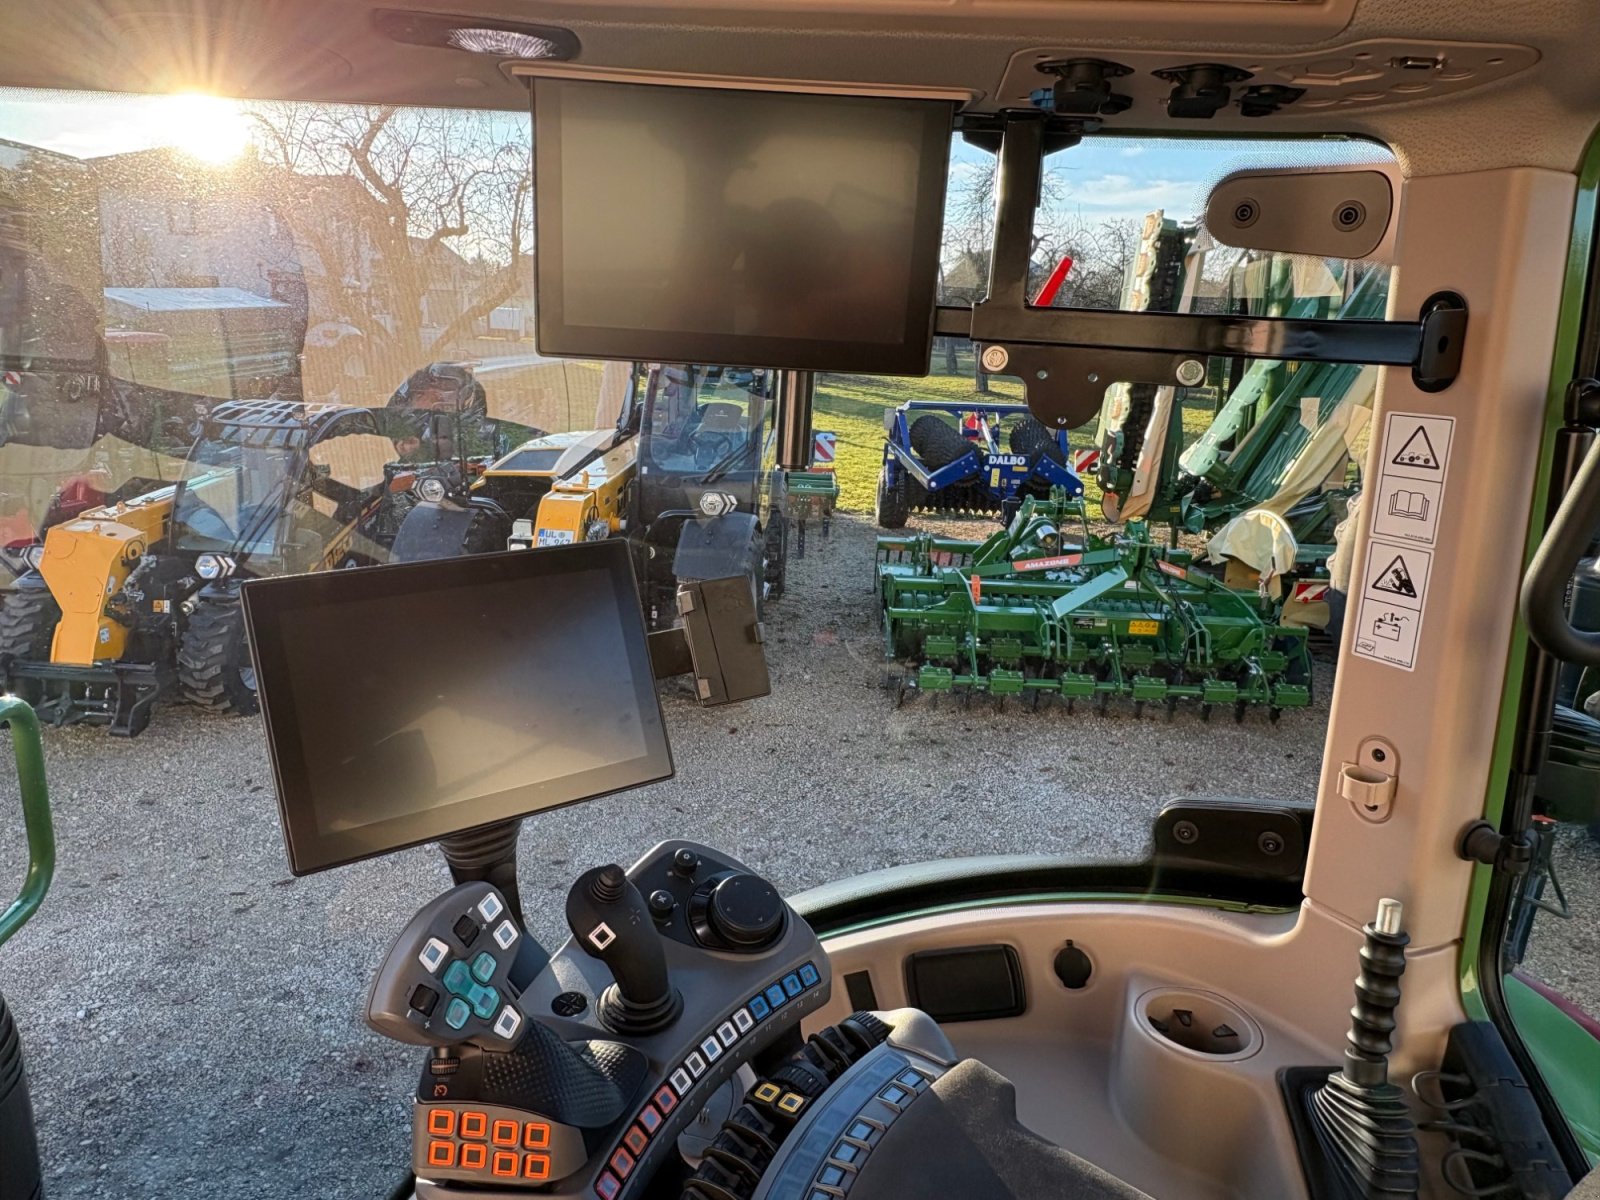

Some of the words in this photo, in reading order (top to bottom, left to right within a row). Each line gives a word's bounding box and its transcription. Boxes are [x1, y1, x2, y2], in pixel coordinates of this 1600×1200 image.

[989, 455, 1026, 466] DALBO
[545, 530, 557, 539] UL
[1024, 558, 1069, 569] AMAZONE
